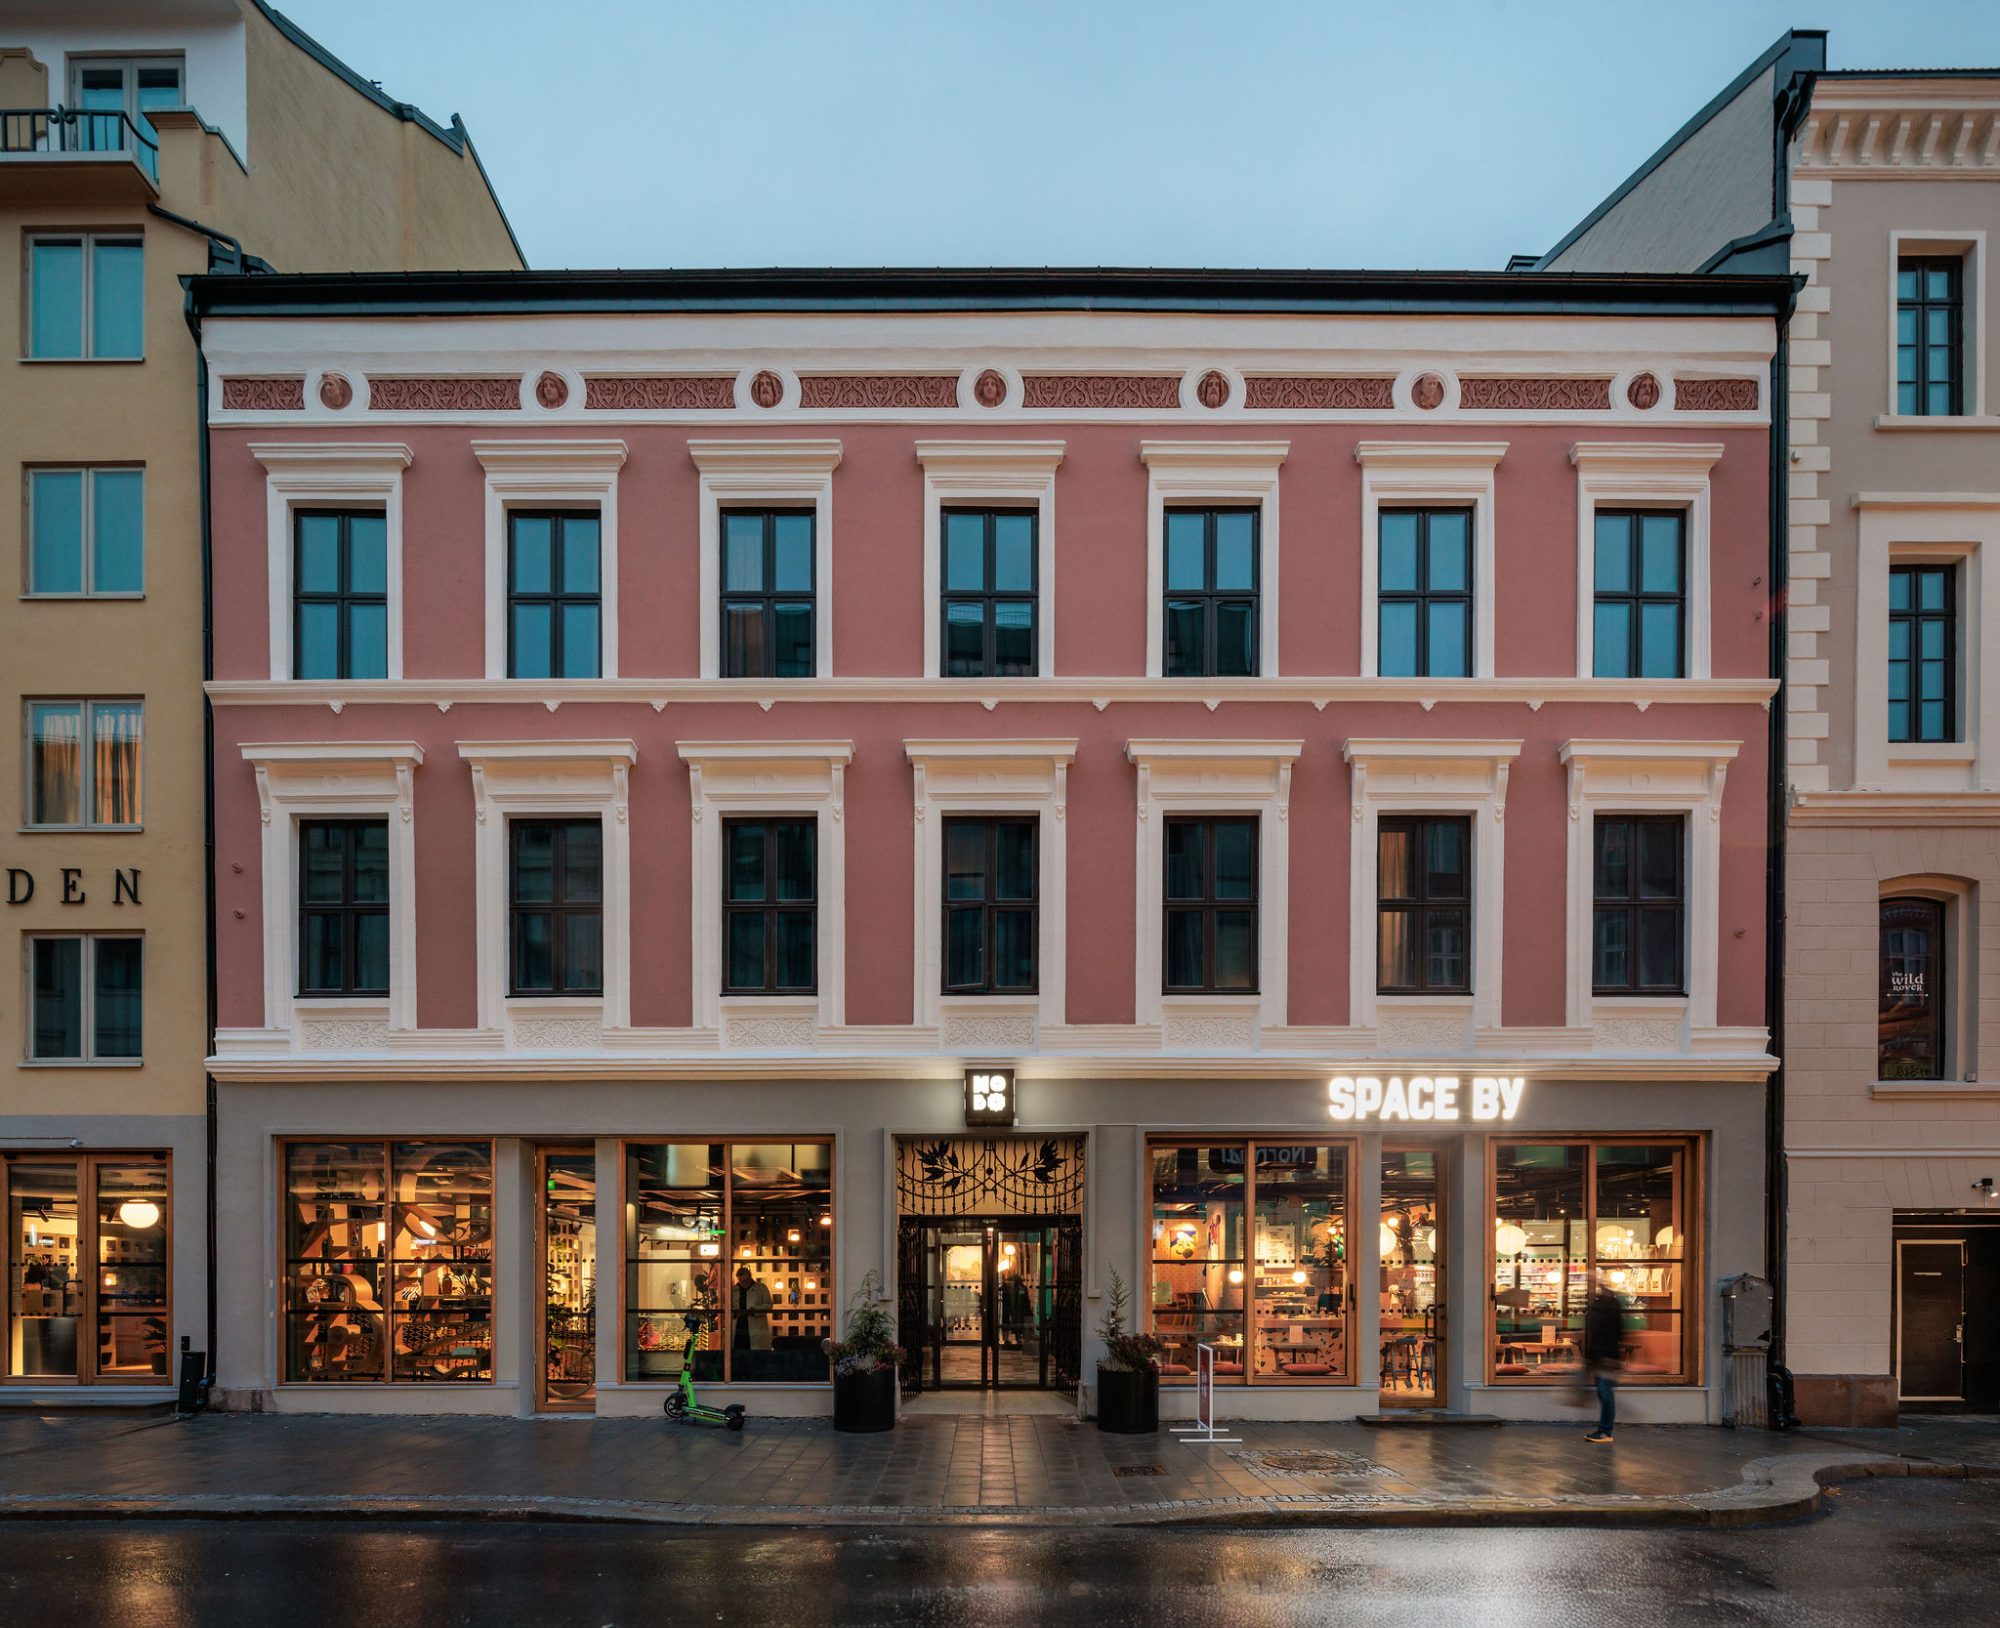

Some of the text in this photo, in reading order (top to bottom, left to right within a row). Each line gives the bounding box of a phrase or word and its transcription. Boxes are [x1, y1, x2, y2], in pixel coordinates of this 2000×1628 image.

[1892, 973, 1924, 985] wild
[1328, 1076, 1525, 1120] SPACE BY
